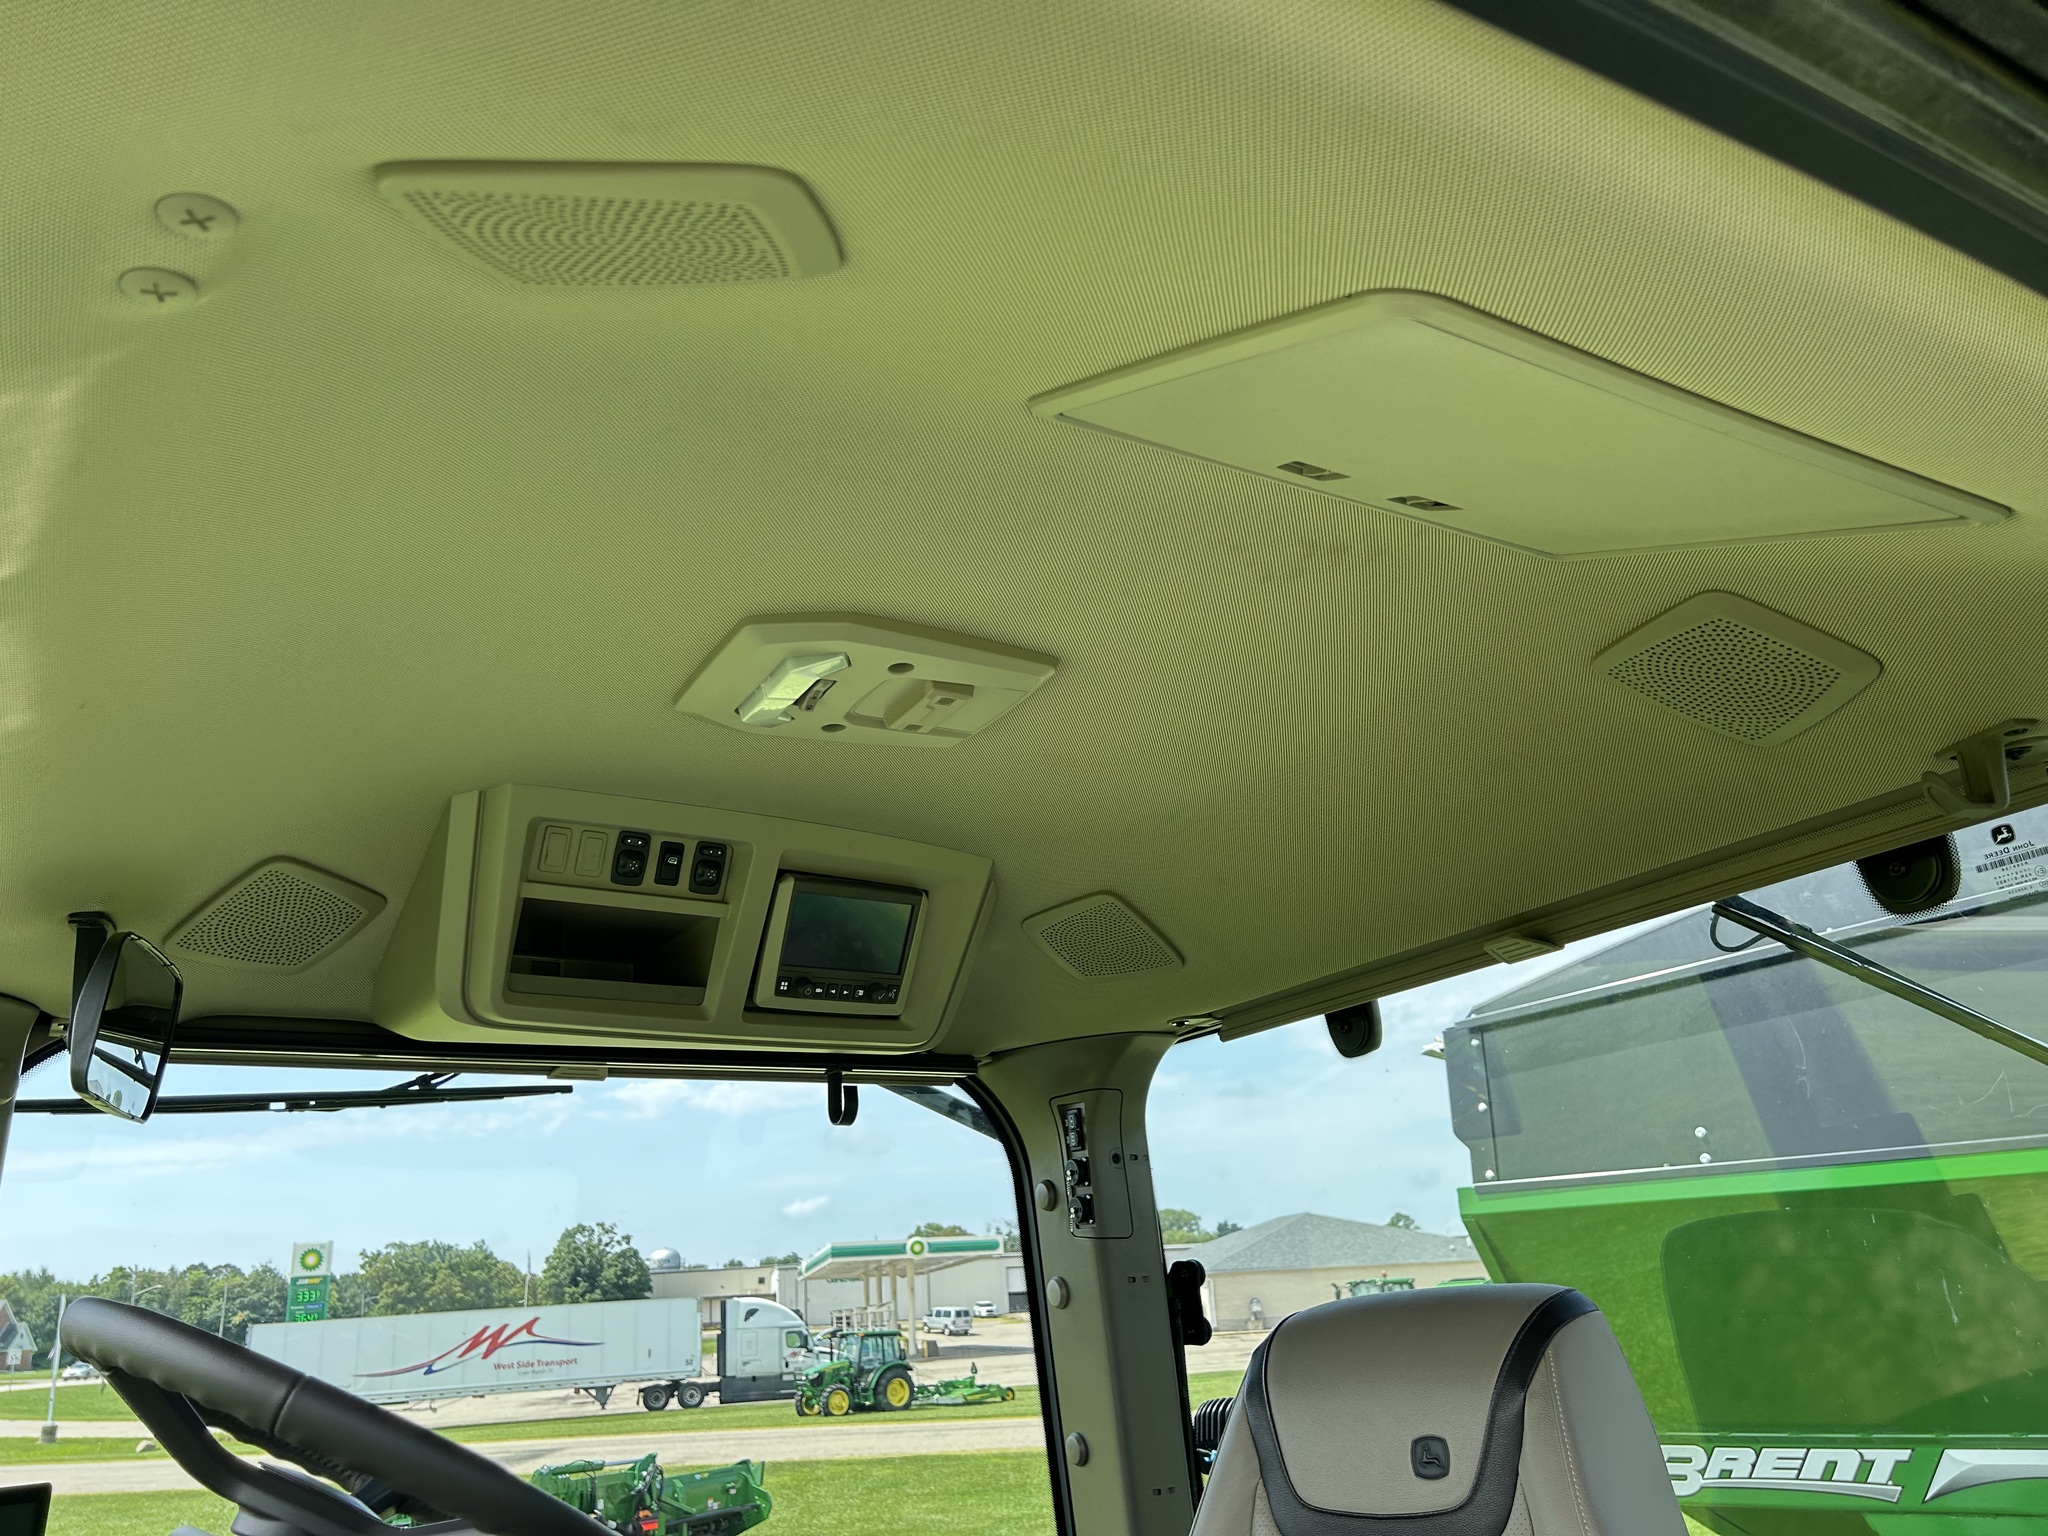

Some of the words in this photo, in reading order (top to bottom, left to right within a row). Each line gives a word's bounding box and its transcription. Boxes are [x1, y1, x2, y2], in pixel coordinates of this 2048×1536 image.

[493, 1361, 515, 1371] West
[516, 1360, 535, 1369] Side
[536, 1357, 578, 1368] Transport
[1661, 1444, 1912, 1497] BRENT
